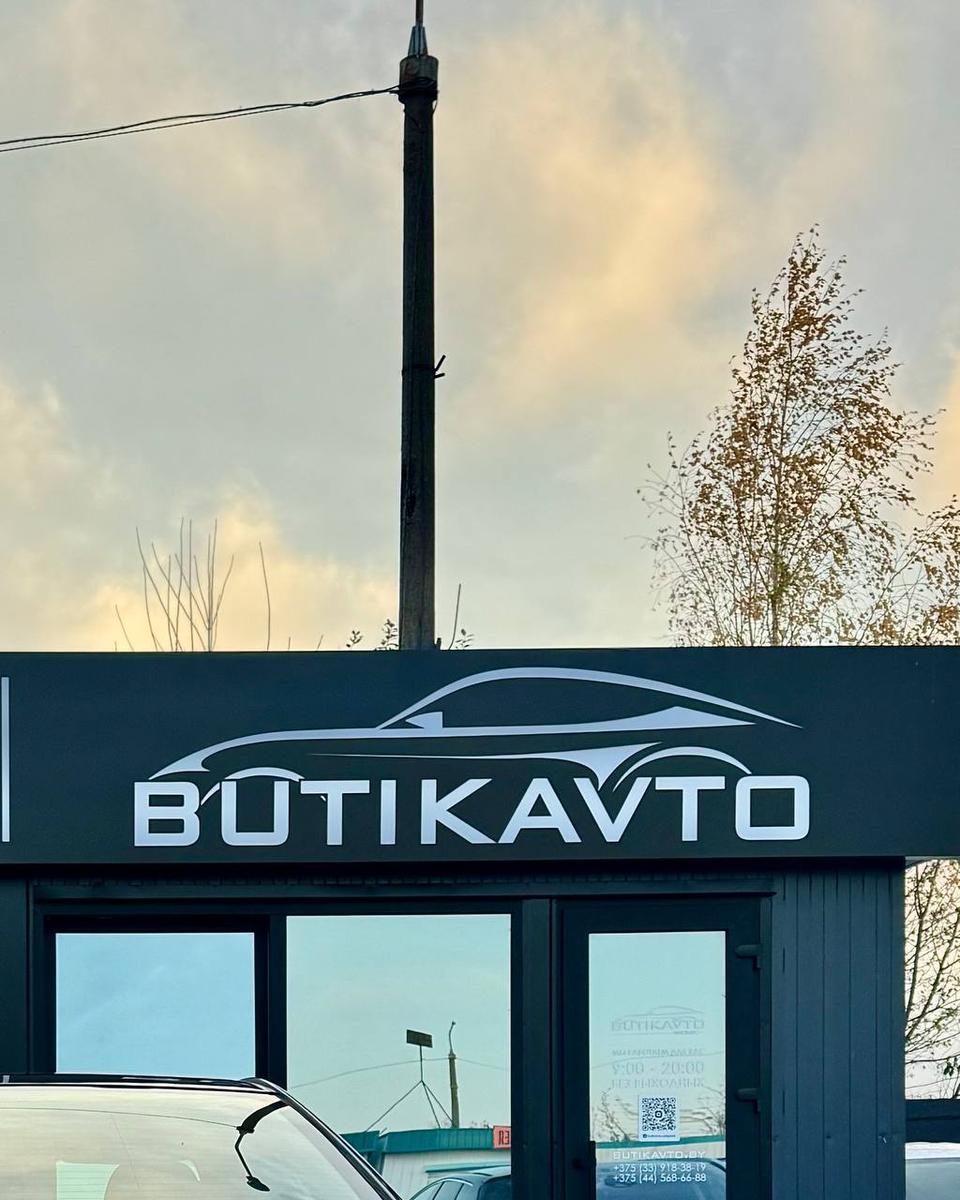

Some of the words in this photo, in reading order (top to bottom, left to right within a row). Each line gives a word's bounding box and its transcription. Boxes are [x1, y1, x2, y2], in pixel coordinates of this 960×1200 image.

[133, 774, 811, 848] BUTIKAVTO
[612, 1062, 645, 1075] 9:00
[661, 1061, 704, 1075] 20:00
[613, 1150, 706, 1159] BUTIKAVTO.BY
[613, 1164, 636, 1173] +375
[639, 1163, 657, 1174] (33)
[660, 1163, 706, 1172] 918-38-19
[613, 1173, 636, 1183] +375
[639, 1173, 657, 1184] (44)
[660, 1173, 707, 1183] 568-66-88
